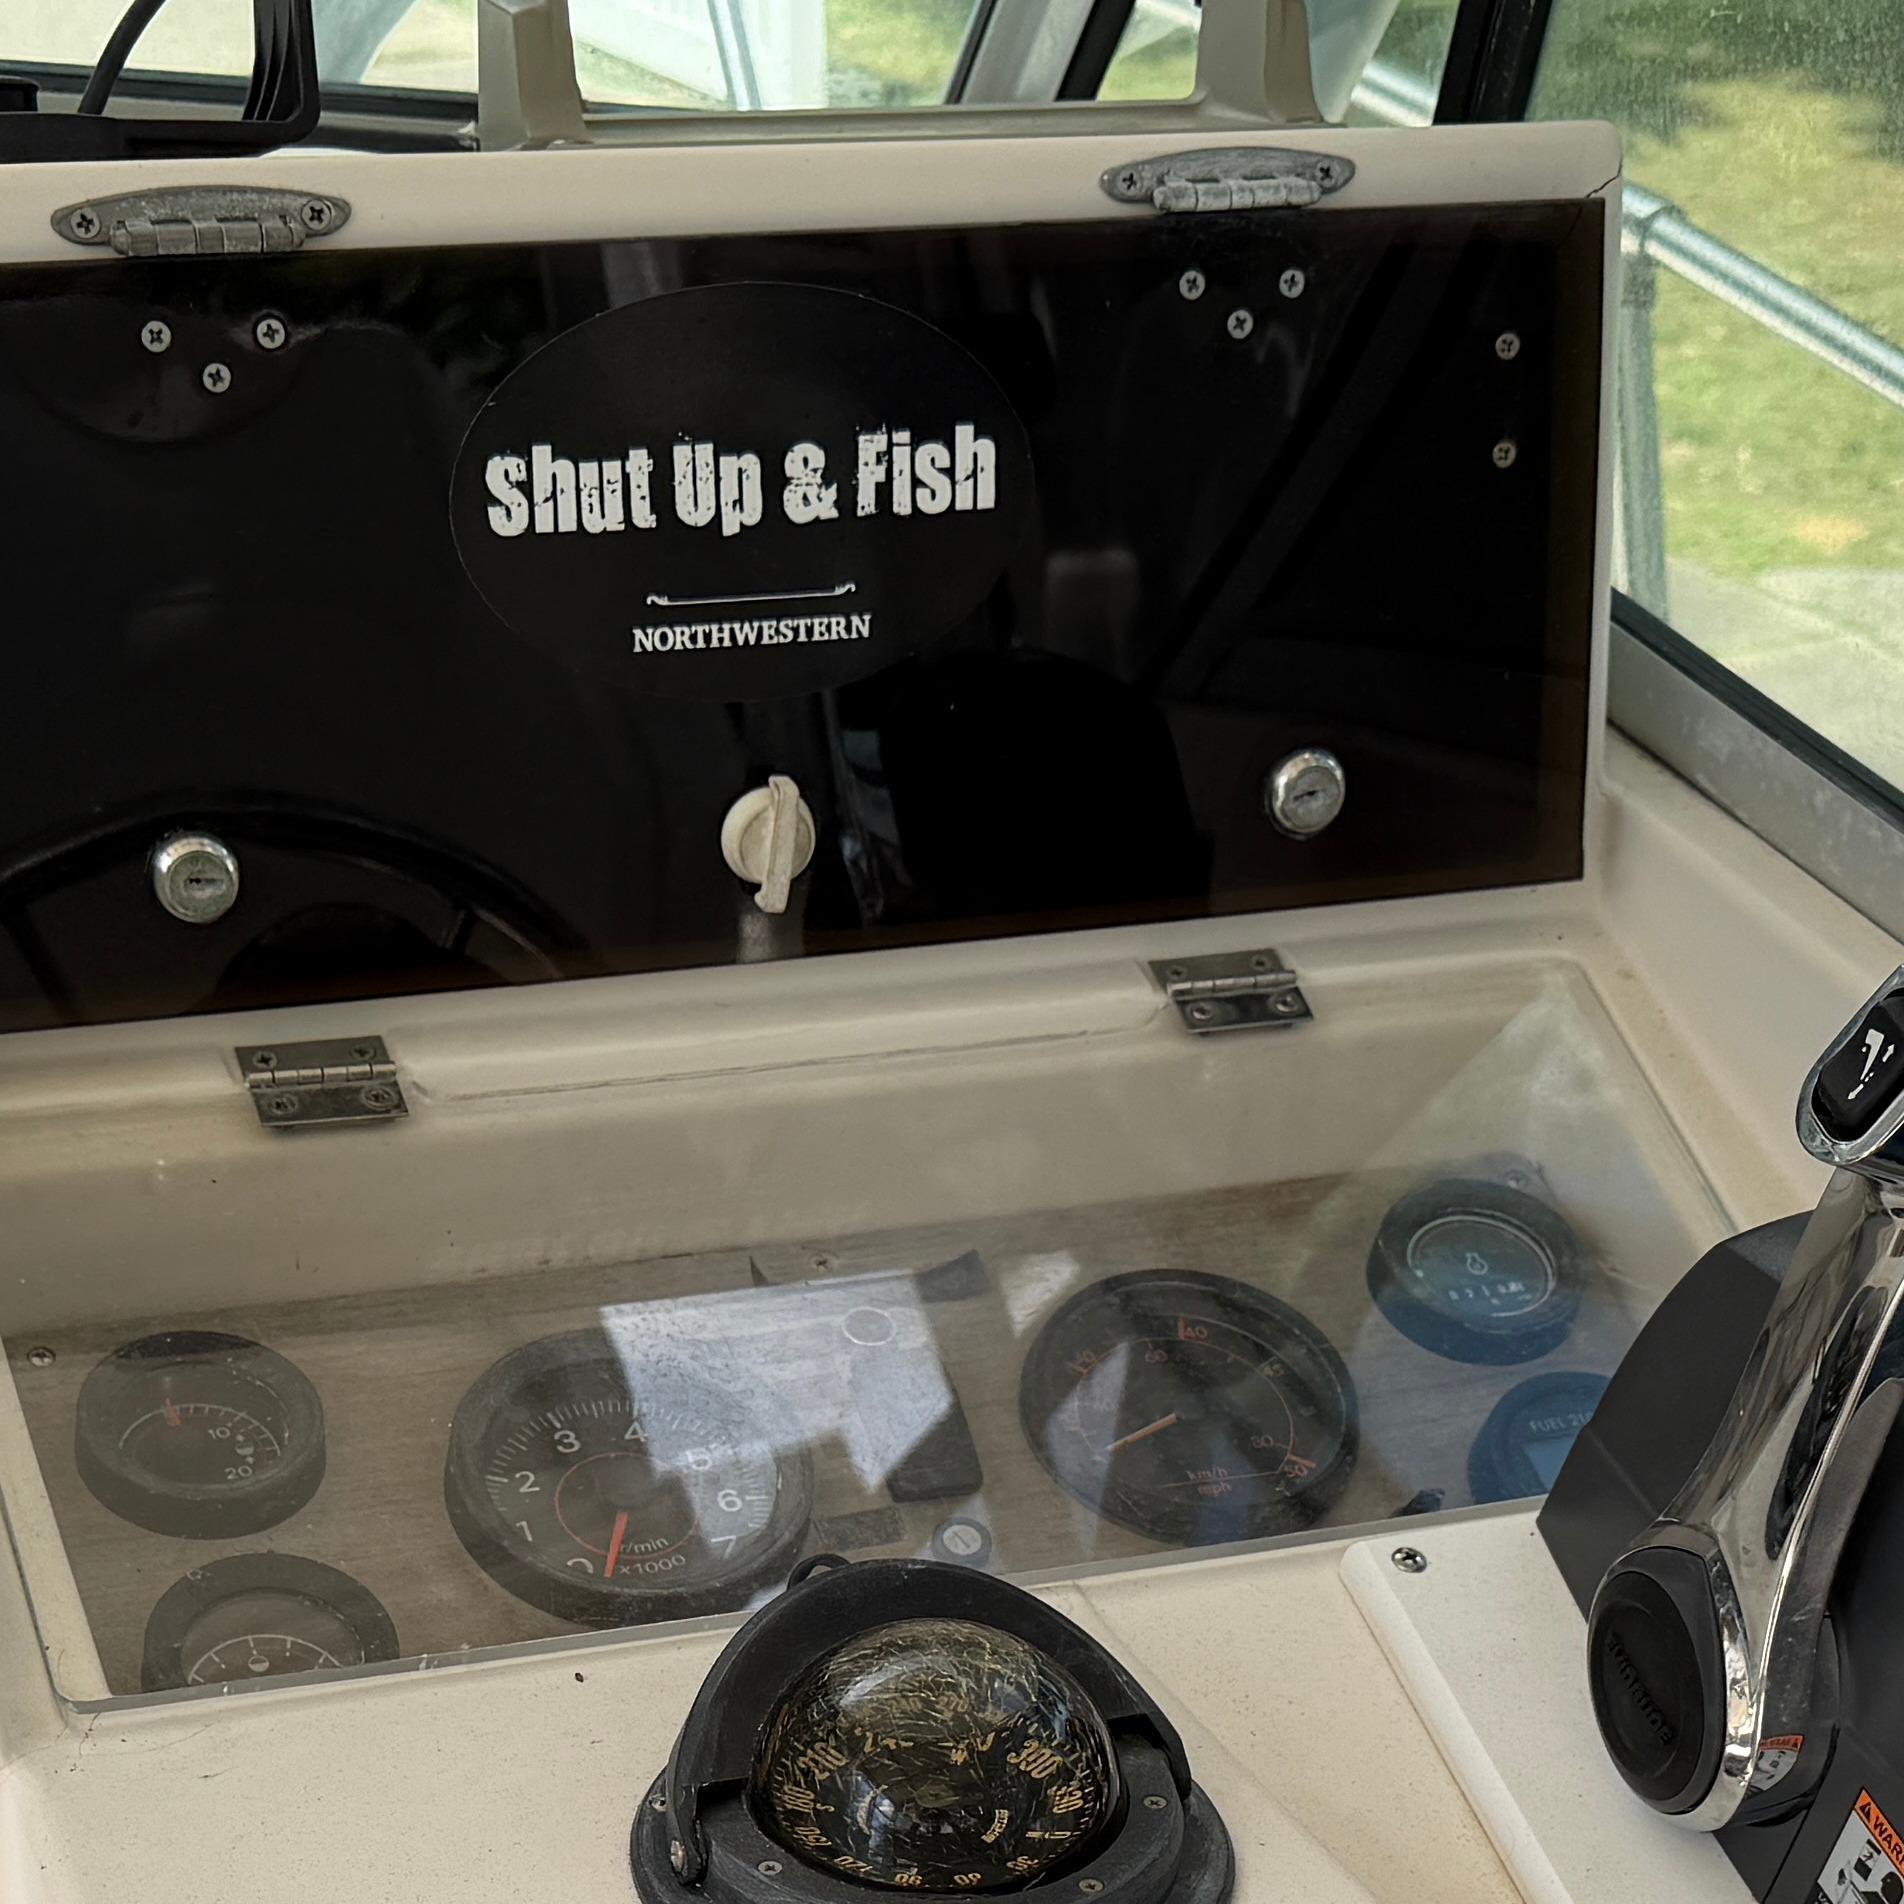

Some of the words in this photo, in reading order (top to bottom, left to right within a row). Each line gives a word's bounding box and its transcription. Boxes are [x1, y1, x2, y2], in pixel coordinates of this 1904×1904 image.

[485, 444, 656, 536] Shut
[672, 438, 761, 536] Up
[783, 442, 838, 524] &
[856, 422, 996, 516] Fish
[632, 612, 872, 653] NORTHWESTERN
[209, 1426, 230, 1439] 10
[554, 1430, 582, 1454] 3
[623, 1422, 649, 1444] 4
[685, 1449, 713, 1471] 5
[226, 1465, 252, 1480] 20
[515, 1471, 541, 1494] 2
[717, 1488, 744, 1512] 6
[1197, 1482, 1233, 1497] mph
[515, 1520, 534, 1542] 1
[710, 1535, 737, 1559] 7
